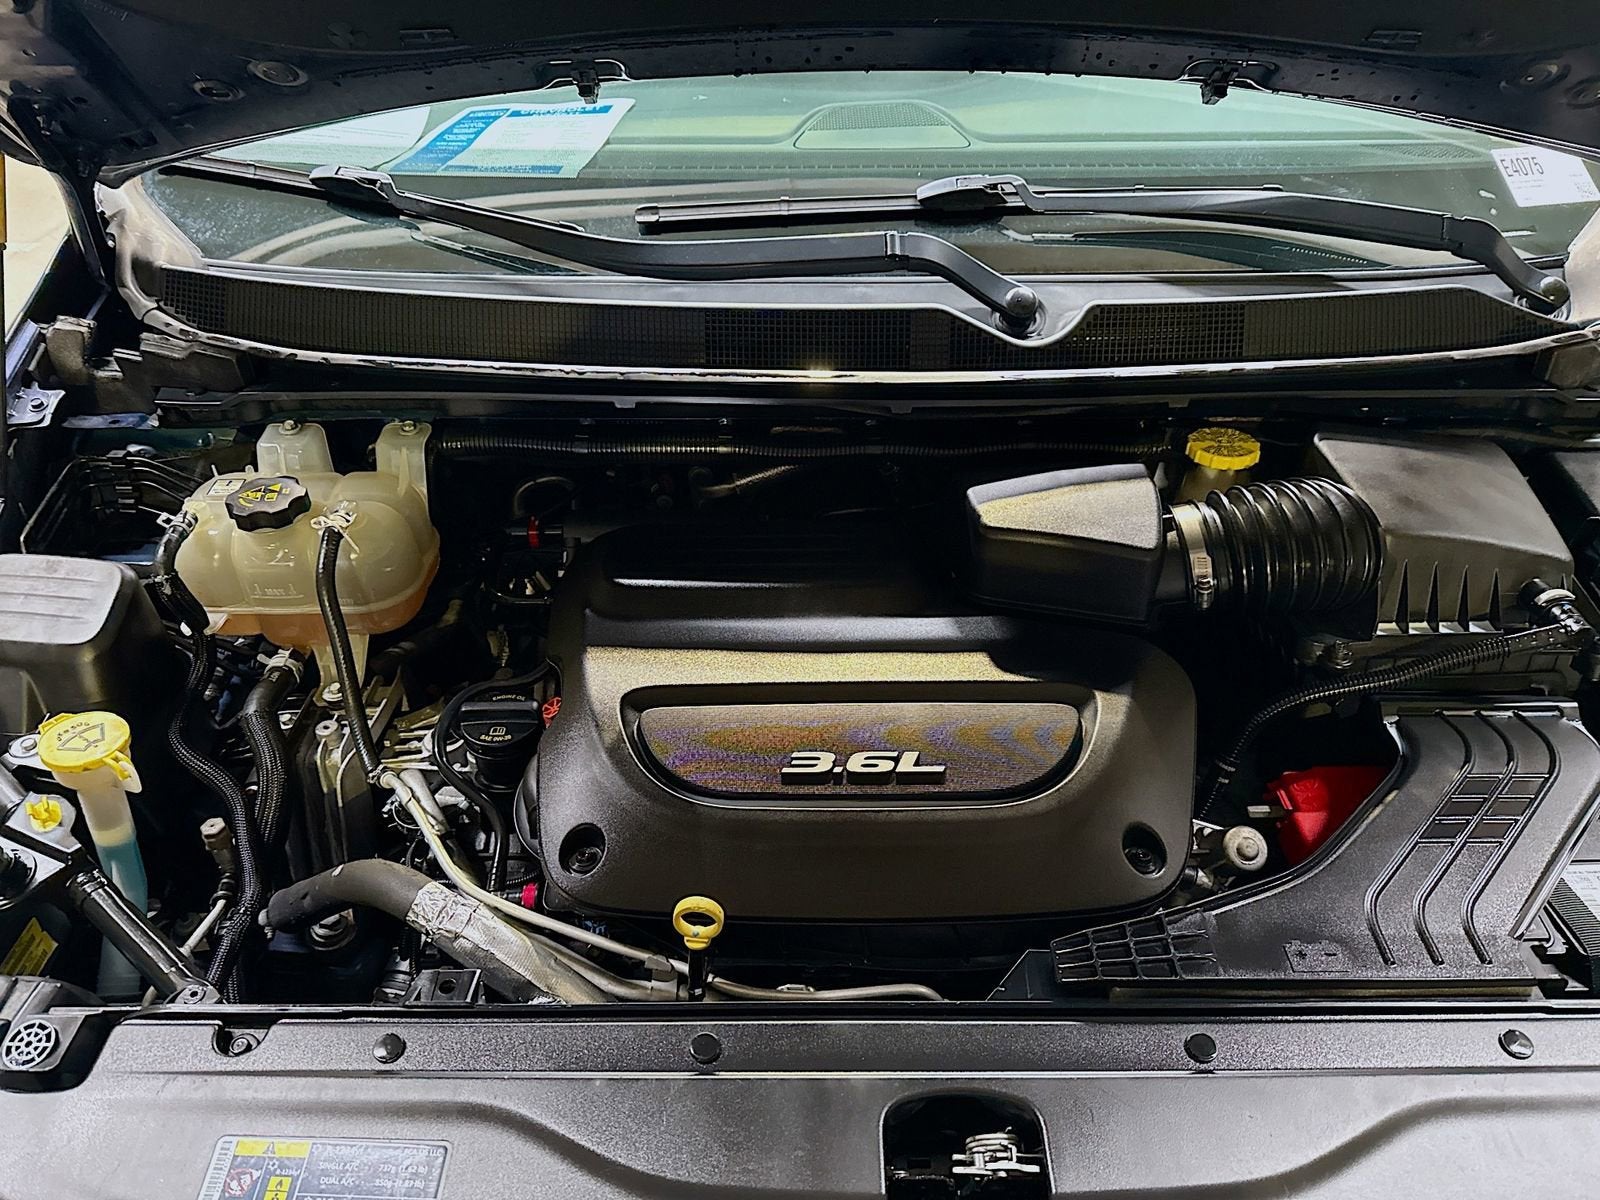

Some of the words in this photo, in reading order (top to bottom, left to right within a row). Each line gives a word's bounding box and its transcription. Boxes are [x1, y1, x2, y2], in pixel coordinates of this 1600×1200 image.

[1500, 156, 1544, 177] E4075
[781, 751, 947, 775] 3.6L
[320, 1176, 339, 1185] DUAL
